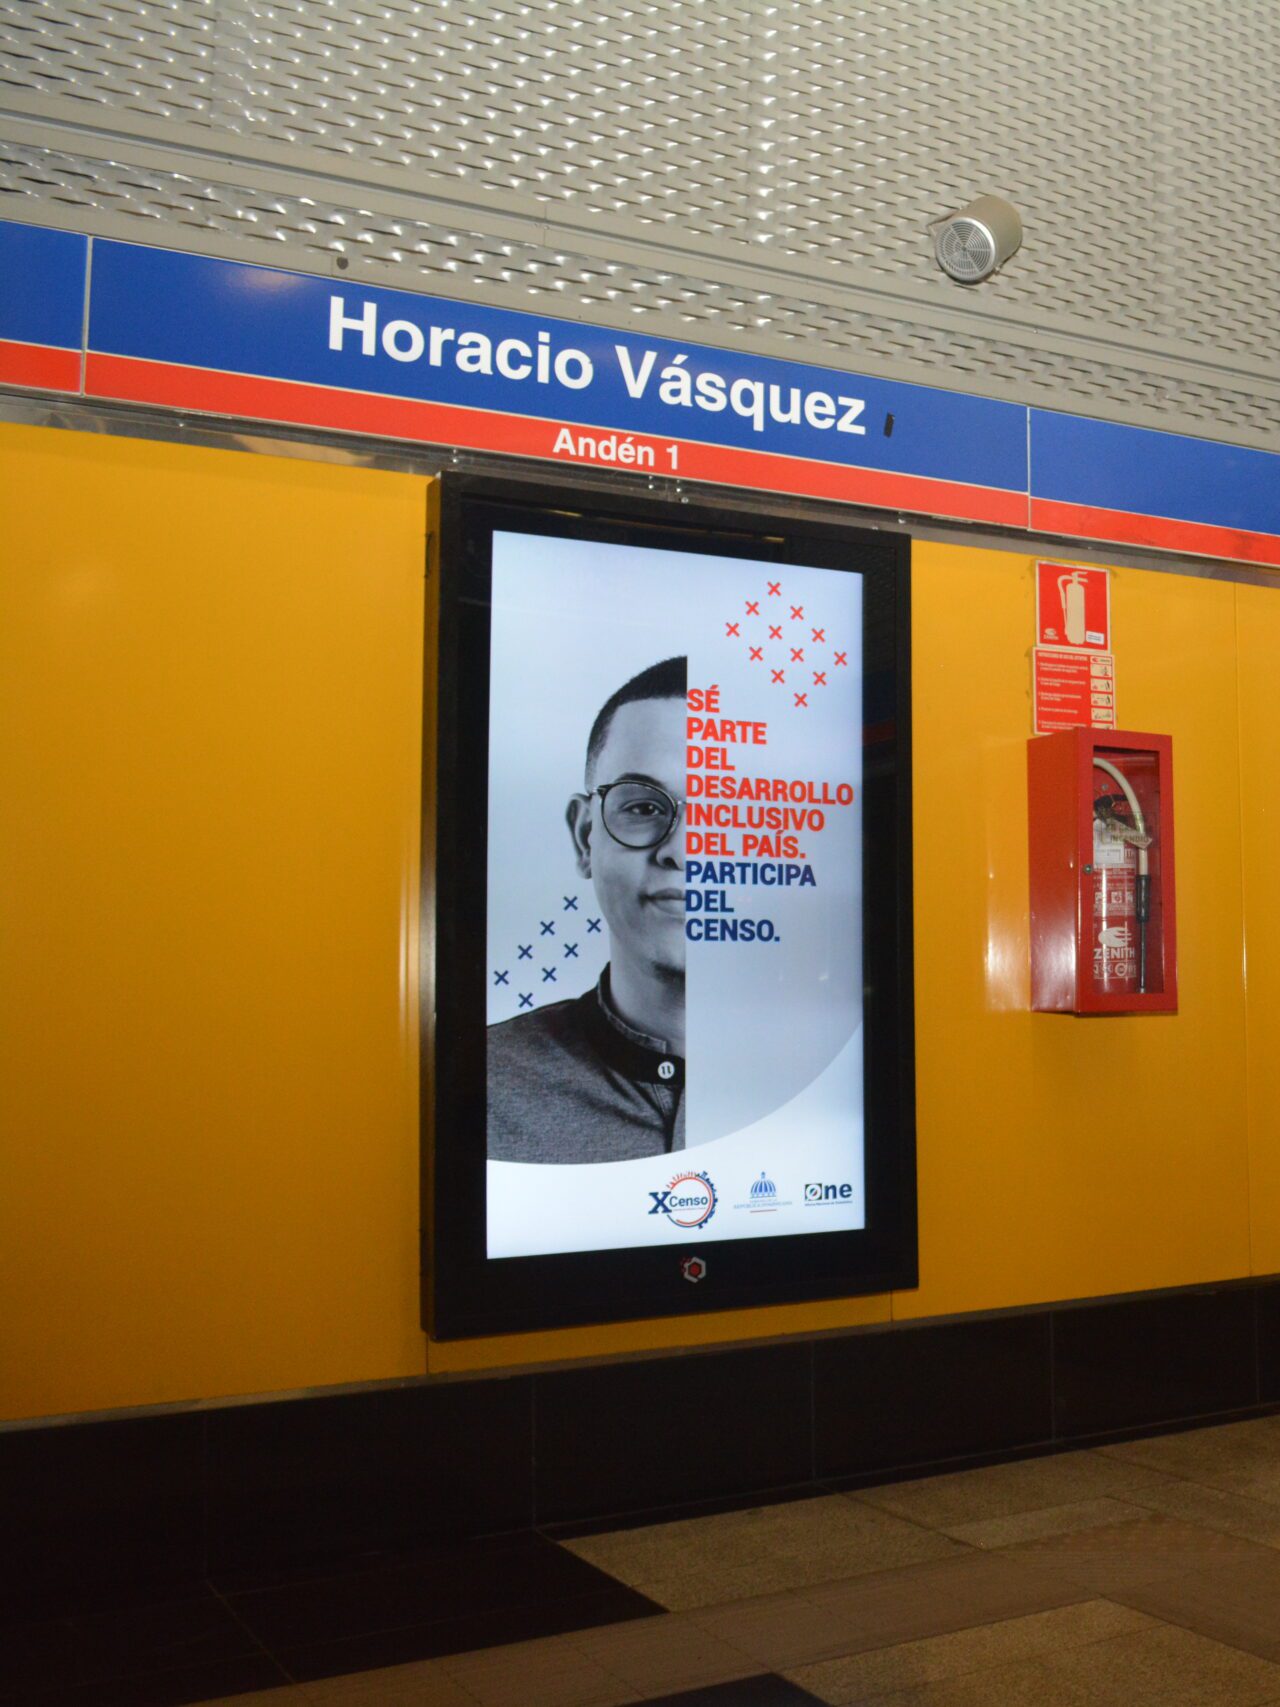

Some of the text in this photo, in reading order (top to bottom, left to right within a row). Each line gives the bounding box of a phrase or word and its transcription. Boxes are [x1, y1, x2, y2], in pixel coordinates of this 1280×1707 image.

[329, 296, 867, 434] Horacio Vásquez
[552, 428, 678, 470] Andén 1
[686, 685, 720, 713] SÉ
[686, 717, 767, 745] PARTE
[686, 745, 735, 771] DEL
[686, 774, 854, 805] DESARROLLO
[685, 803, 825, 831] INCLUSIVO
[685, 830, 806, 859] DEL PAÍS.
[685, 861, 817, 887] PARTICIPA
[685, 889, 735, 913] DEL
[685, 918, 780, 942] CENSO.
